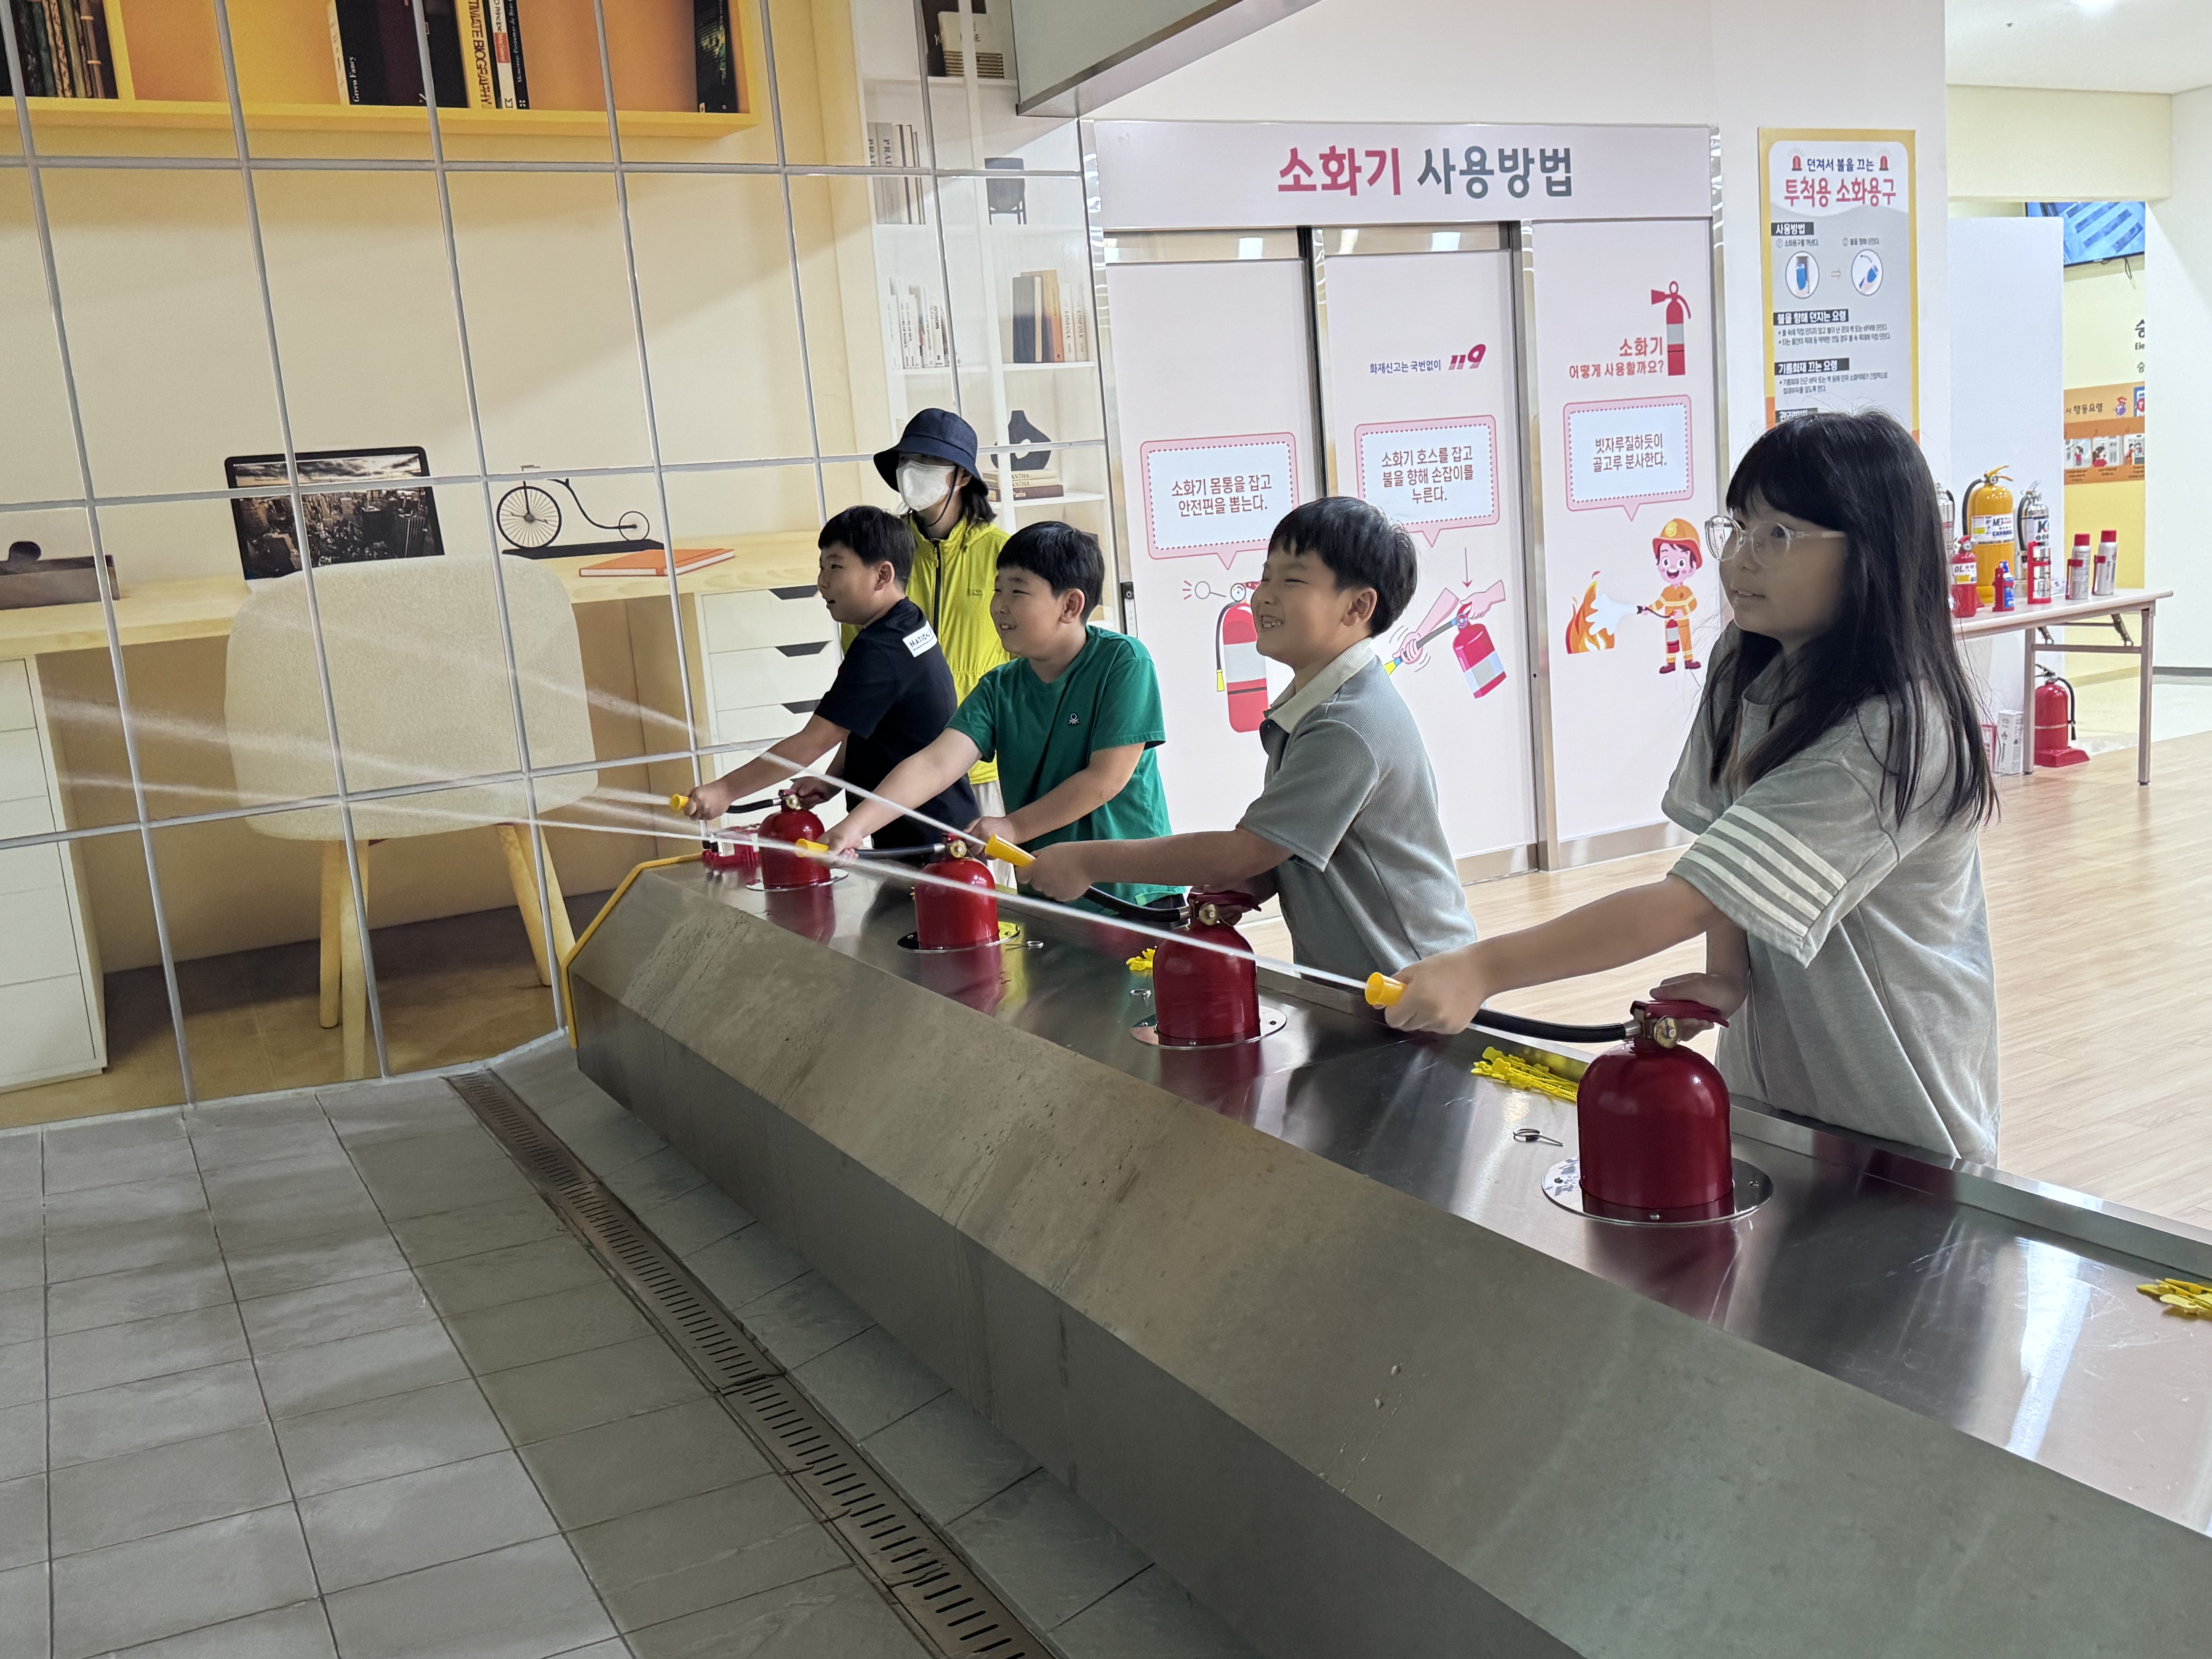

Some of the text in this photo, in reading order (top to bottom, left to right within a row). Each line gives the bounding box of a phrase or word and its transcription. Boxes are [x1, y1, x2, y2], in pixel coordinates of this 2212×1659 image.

[1278, 145, 1572, 199] 소화기 사용방법
[1837, 158, 1854, 172] 불을
[1856, 158, 1874, 172] 끄는
[1784, 176, 1896, 208] 투척용 소화용구
[1776, 223, 1805, 235] 사용방법
[1793, 312, 1808, 324] 향해
[1809, 311, 1831, 323] 던지는
[1832, 310, 1846, 321] 요령
[1620, 336, 1663, 357] 소화기
[1369, 344, 1486, 374] 화재신고는 국번없이 119
[1569, 360, 1664, 379] 어떻게 사용할까요?
[1778, 360, 1838, 374] 기름화재 끄는 요령
[2073, 403, 2103, 415] 행동요령
[1595, 433, 1663, 454] 빗자루질하듯이
[1382, 446, 1473, 467] 소화기 호스를 잡고
[1593, 451, 1667, 472] 골고루 분사한다.
[1171, 474, 1272, 497] 소화기 몸통을 잡고
[1382, 464, 1474, 488] 불을 향해 손잡이를
[1178, 494, 1267, 517] 안전핀을 뽑는다.
[1412, 486, 1447, 504] 누른다.
